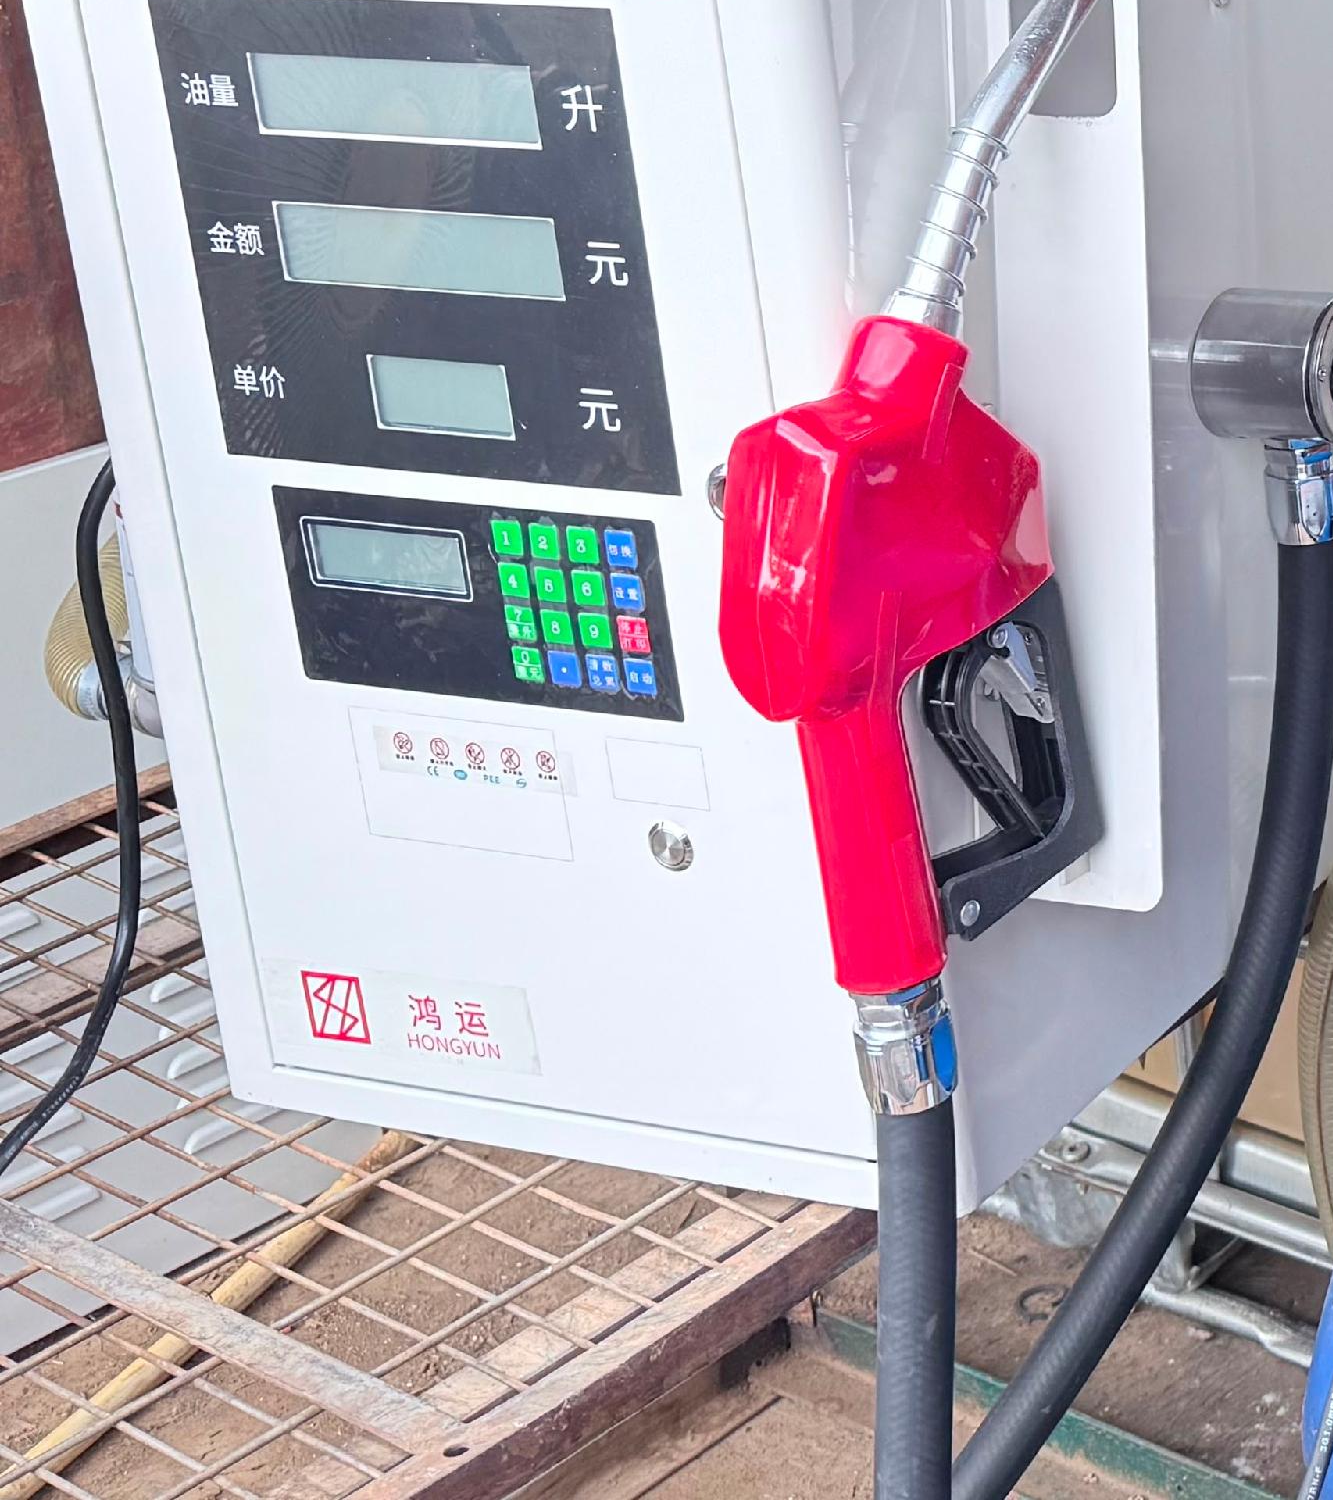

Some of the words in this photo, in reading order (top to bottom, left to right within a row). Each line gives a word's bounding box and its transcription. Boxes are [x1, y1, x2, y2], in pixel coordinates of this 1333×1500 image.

[181, 73, 239, 108] 油量
[562, 85, 603, 132] 升
[207, 221, 264, 257] 金额
[585, 242, 628, 286] 元
[233, 365, 286, 400] 单价
[578, 387, 622, 432] 元
[502, 532, 511, 546] 1
[538, 536, 548, 550] 2
[576, 539, 586, 553] 3
[508, 574, 518, 589] 4
[544, 579, 554, 592] 5
[581, 582, 592, 596] 6
[514, 609, 522, 621] 7
[551, 621, 560, 634] 8
[589, 624, 599, 638] 9
[521, 651, 529, 664] 0
[408, 994, 489, 1037] 鸿运
[407, 1033, 501, 1060] HONGYUN
